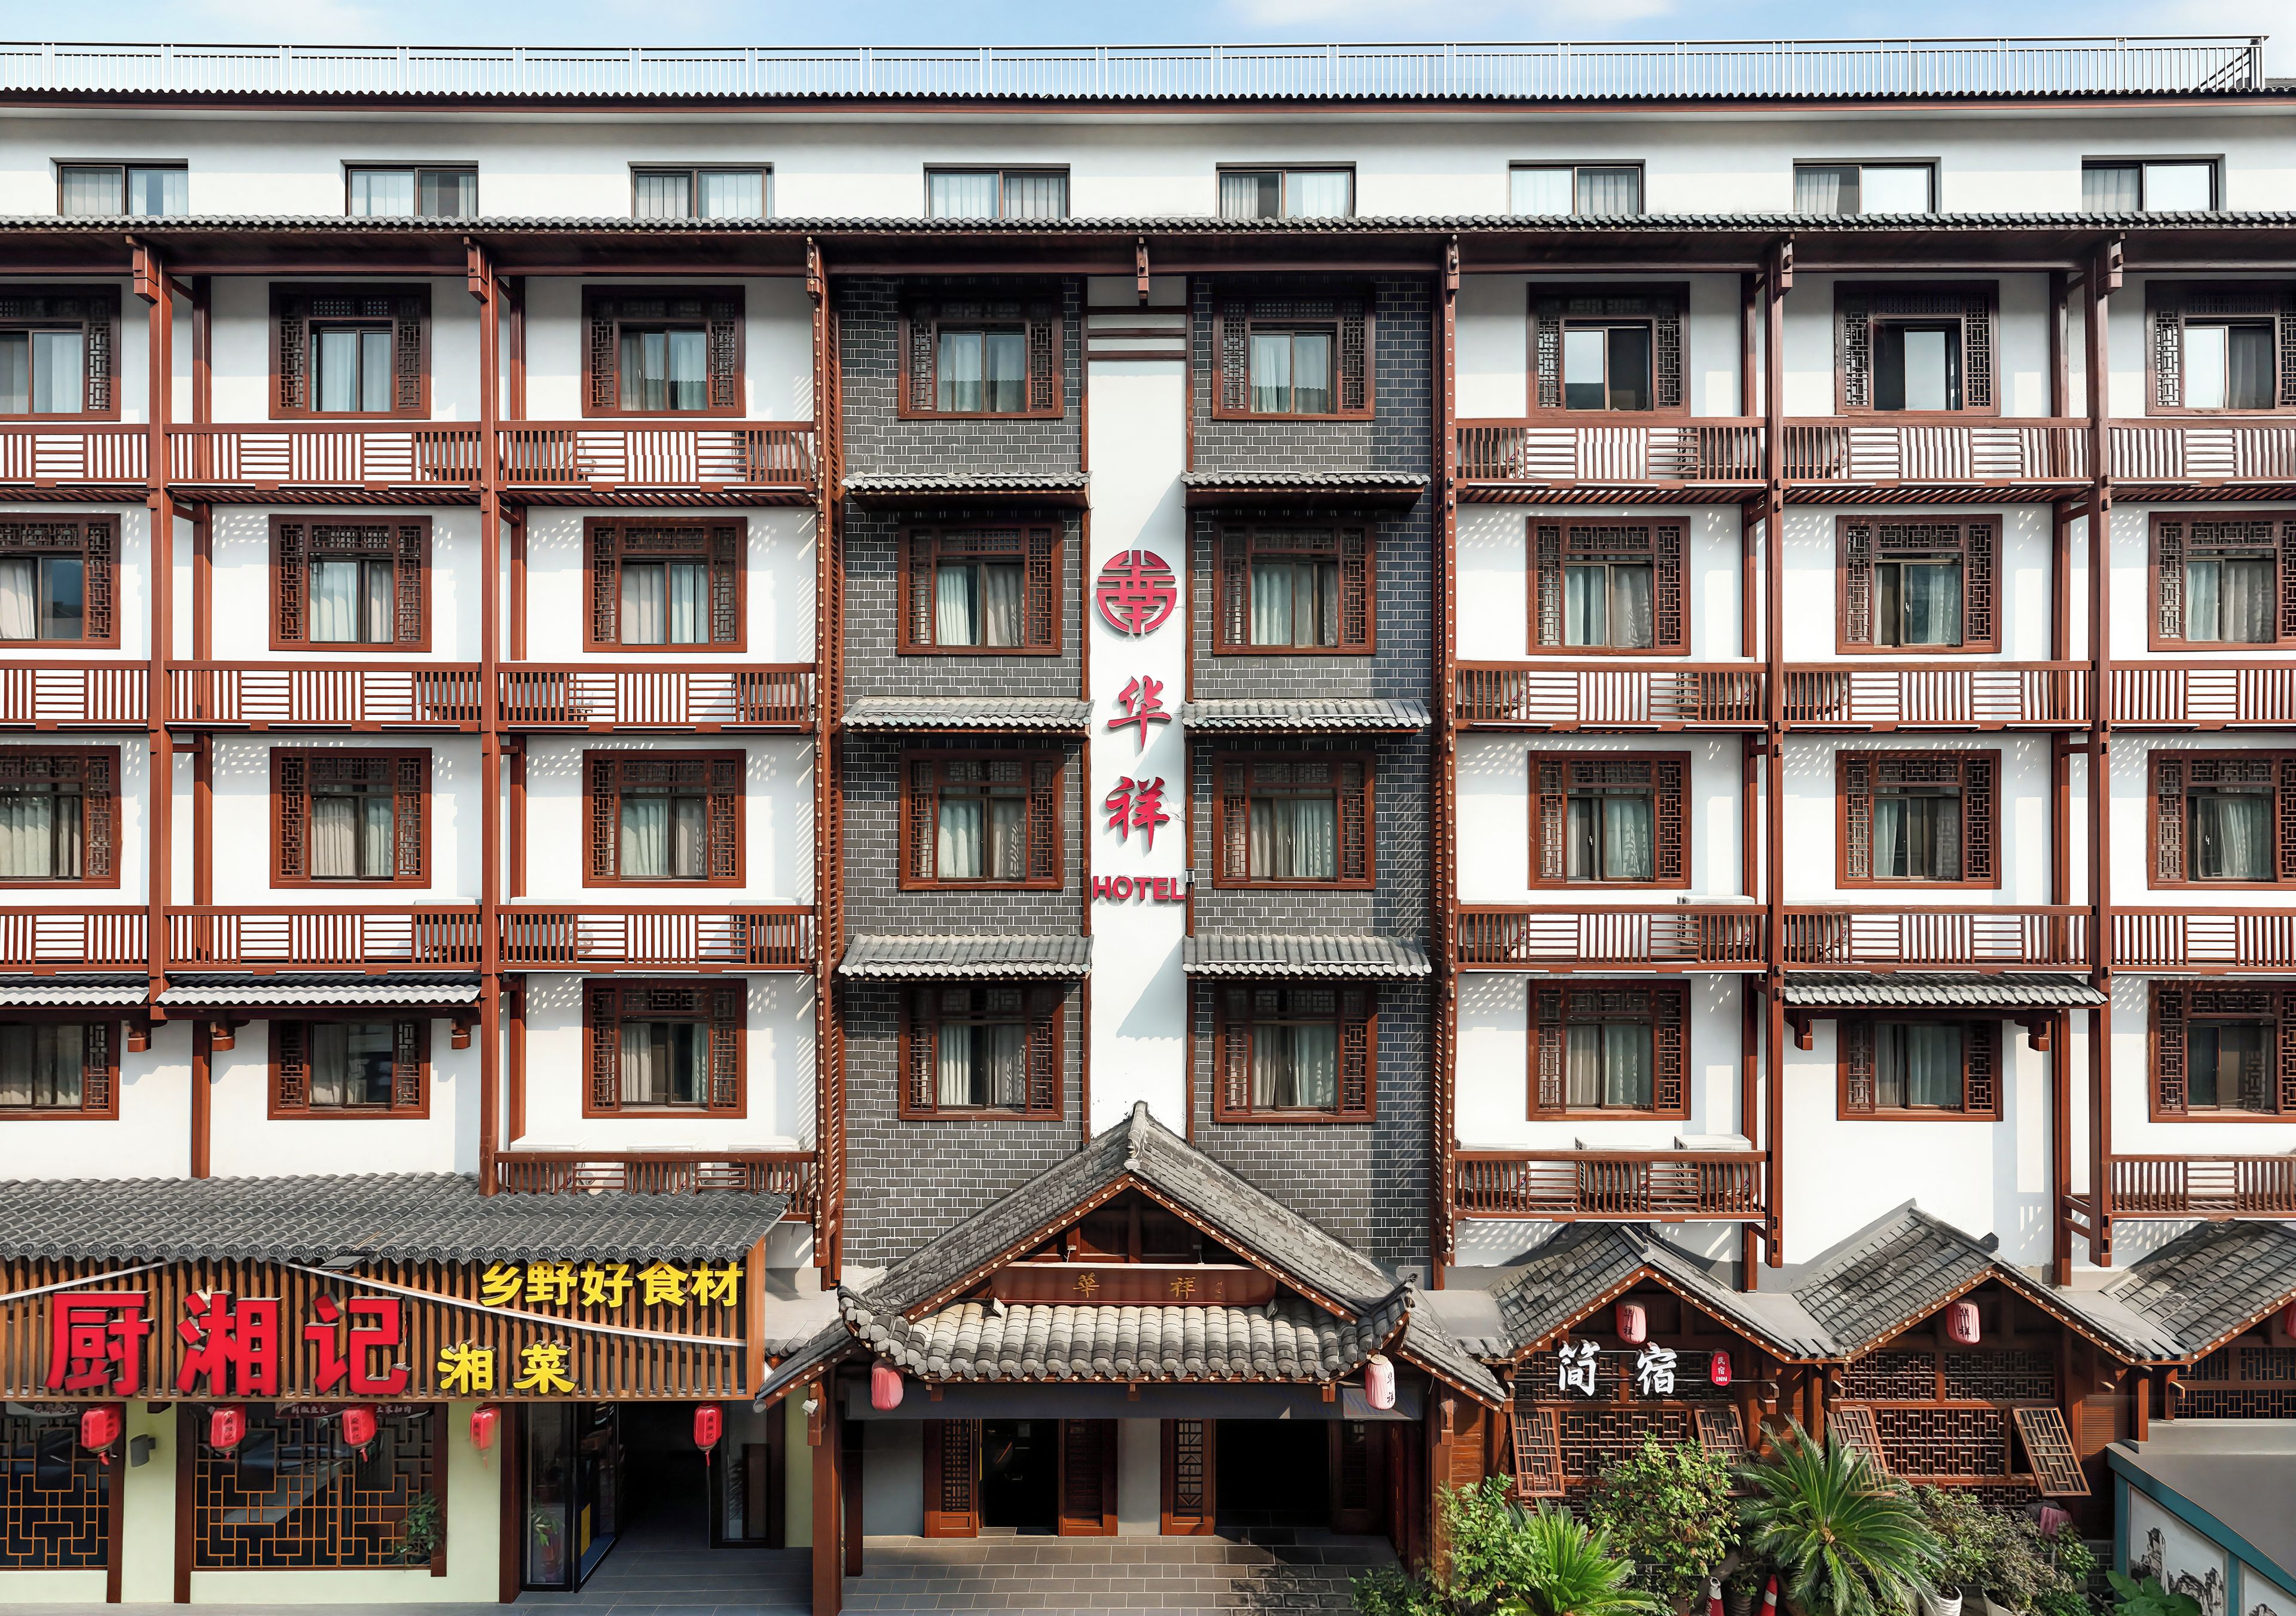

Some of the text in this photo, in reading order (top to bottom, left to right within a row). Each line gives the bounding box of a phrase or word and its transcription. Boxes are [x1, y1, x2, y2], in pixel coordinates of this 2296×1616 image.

[1106, 674, 1172, 853] 华祥
[1093, 875, 1186, 900] HOTEL
[480, 1260, 743, 1308] 乡野好食材
[45, 1289, 413, 1396] 厨湘记
[437, 1342, 577, 1394] 湘菜
[1558, 1338, 1678, 1397] 简宿
[1717, 1356, 1726, 1375] 民宿
